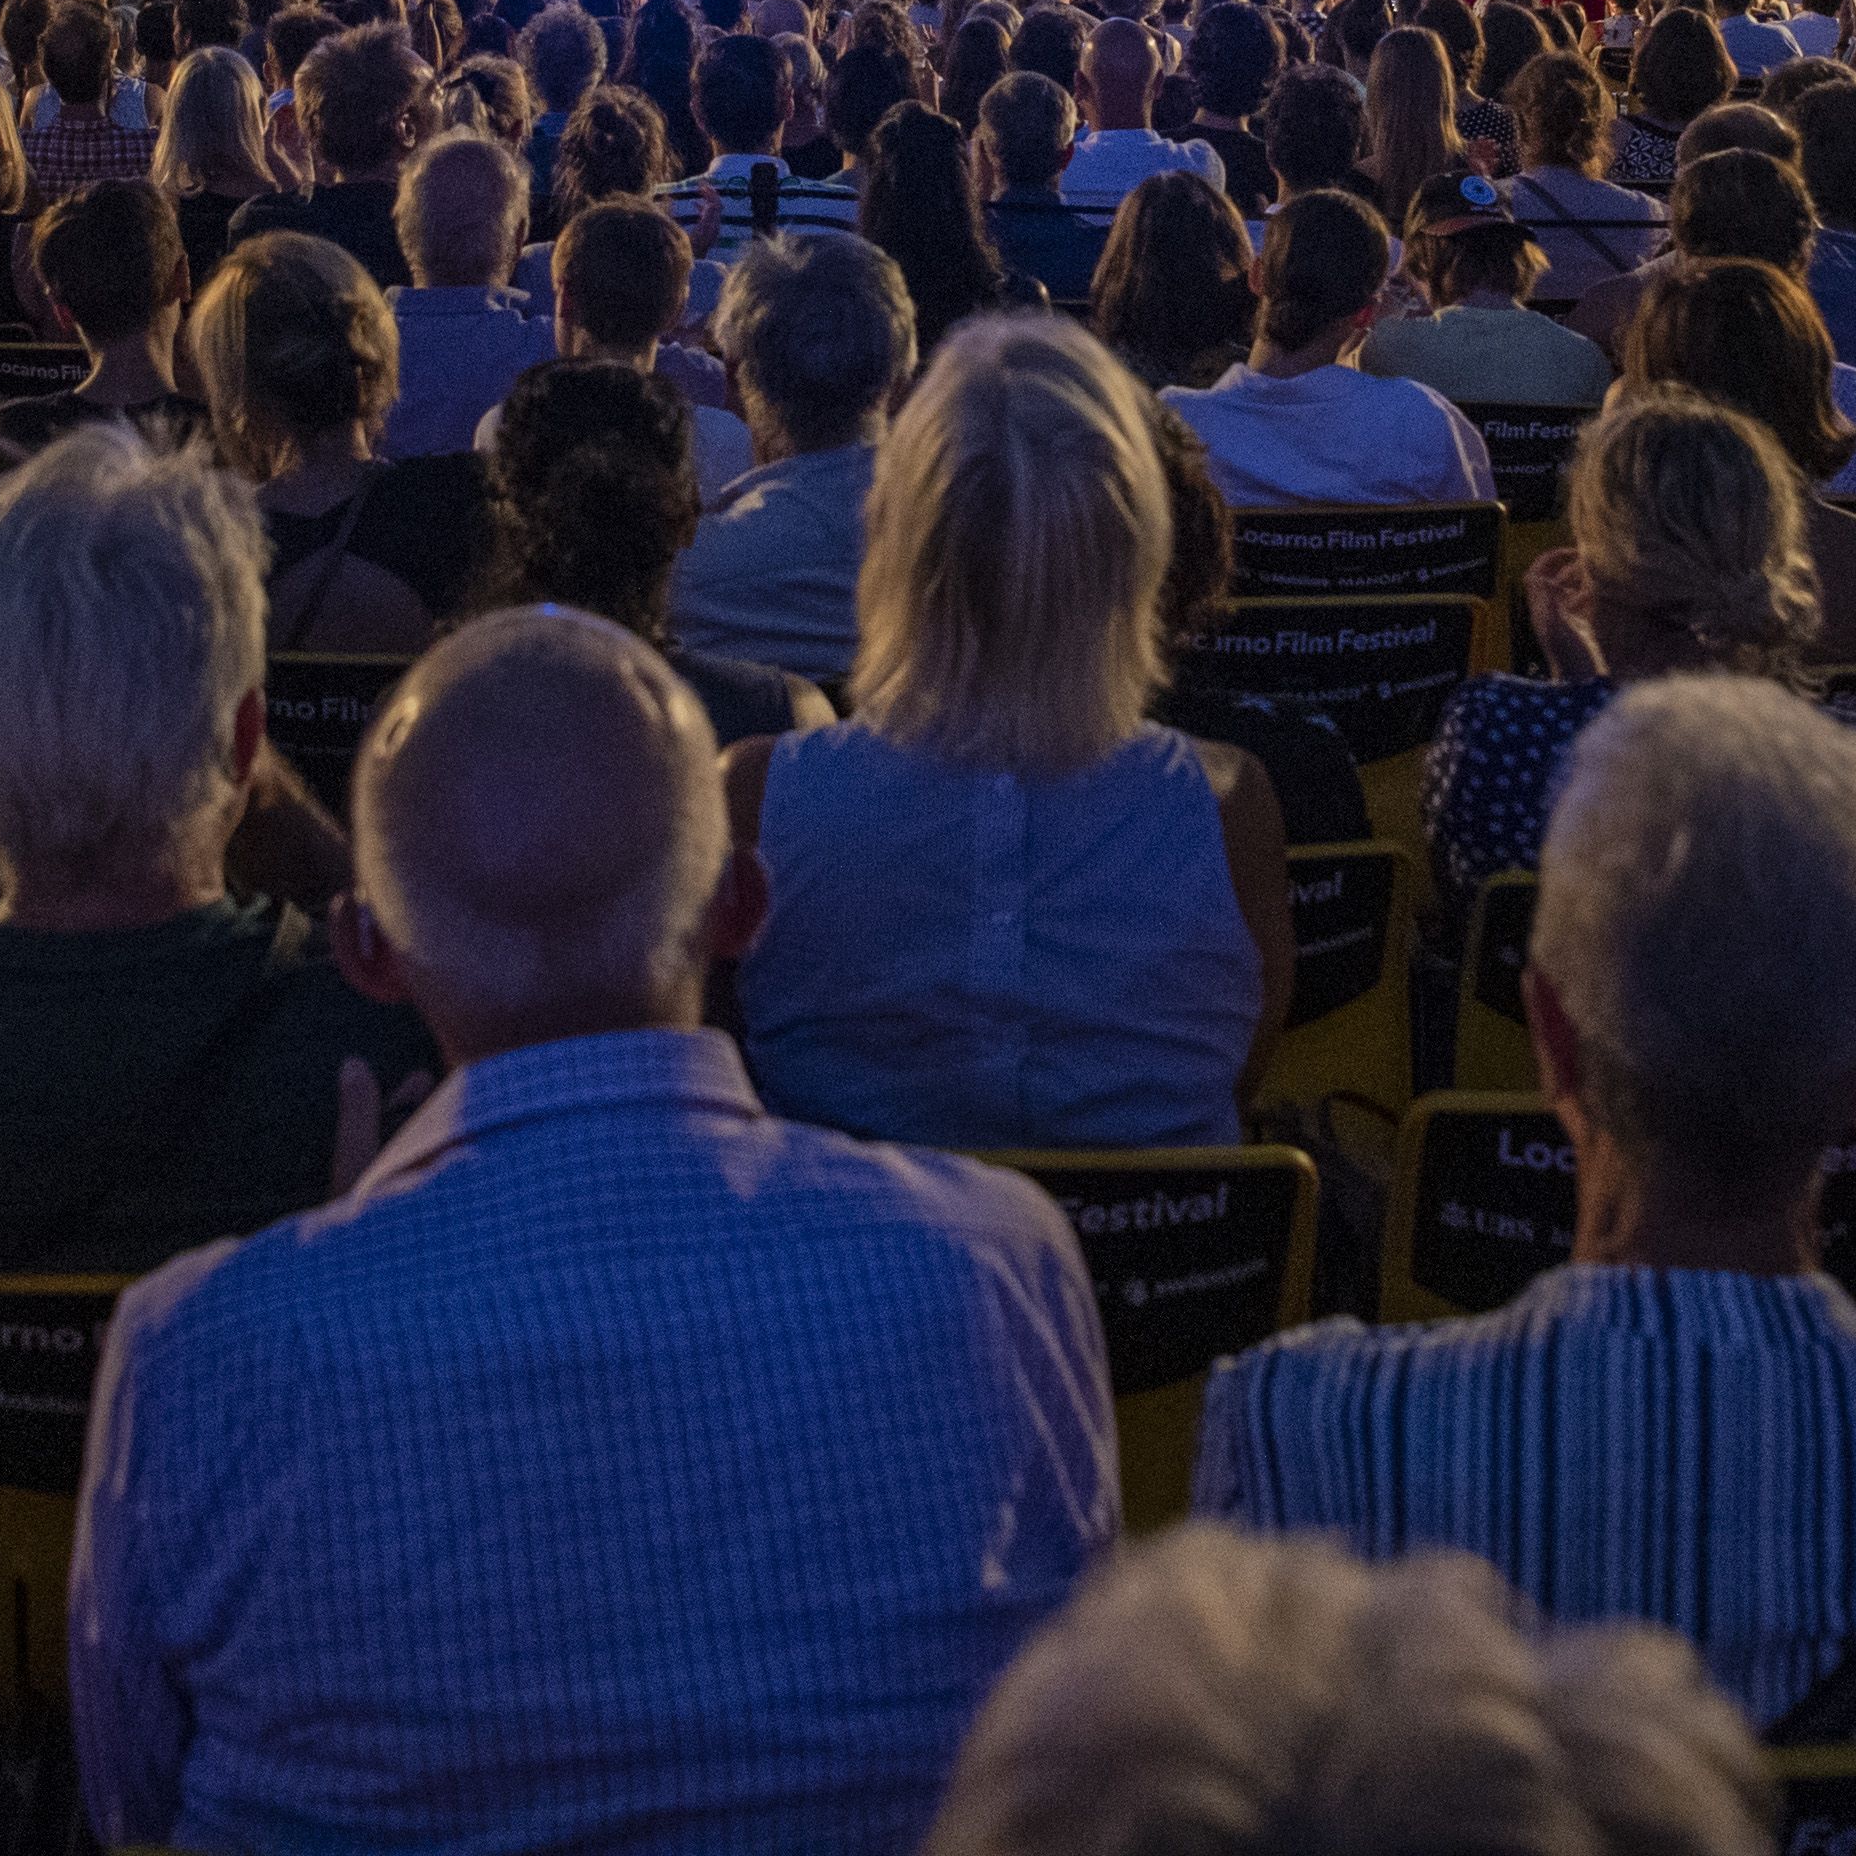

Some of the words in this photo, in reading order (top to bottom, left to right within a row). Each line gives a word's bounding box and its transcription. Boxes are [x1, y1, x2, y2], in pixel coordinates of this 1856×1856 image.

[1483, 420, 1524, 440] Film
[1327, 528, 1376, 550] Film
[1379, 518, 1465, 547] Festival
[1275, 630, 1334, 655] Film
[1337, 618, 1437, 653] Festival
